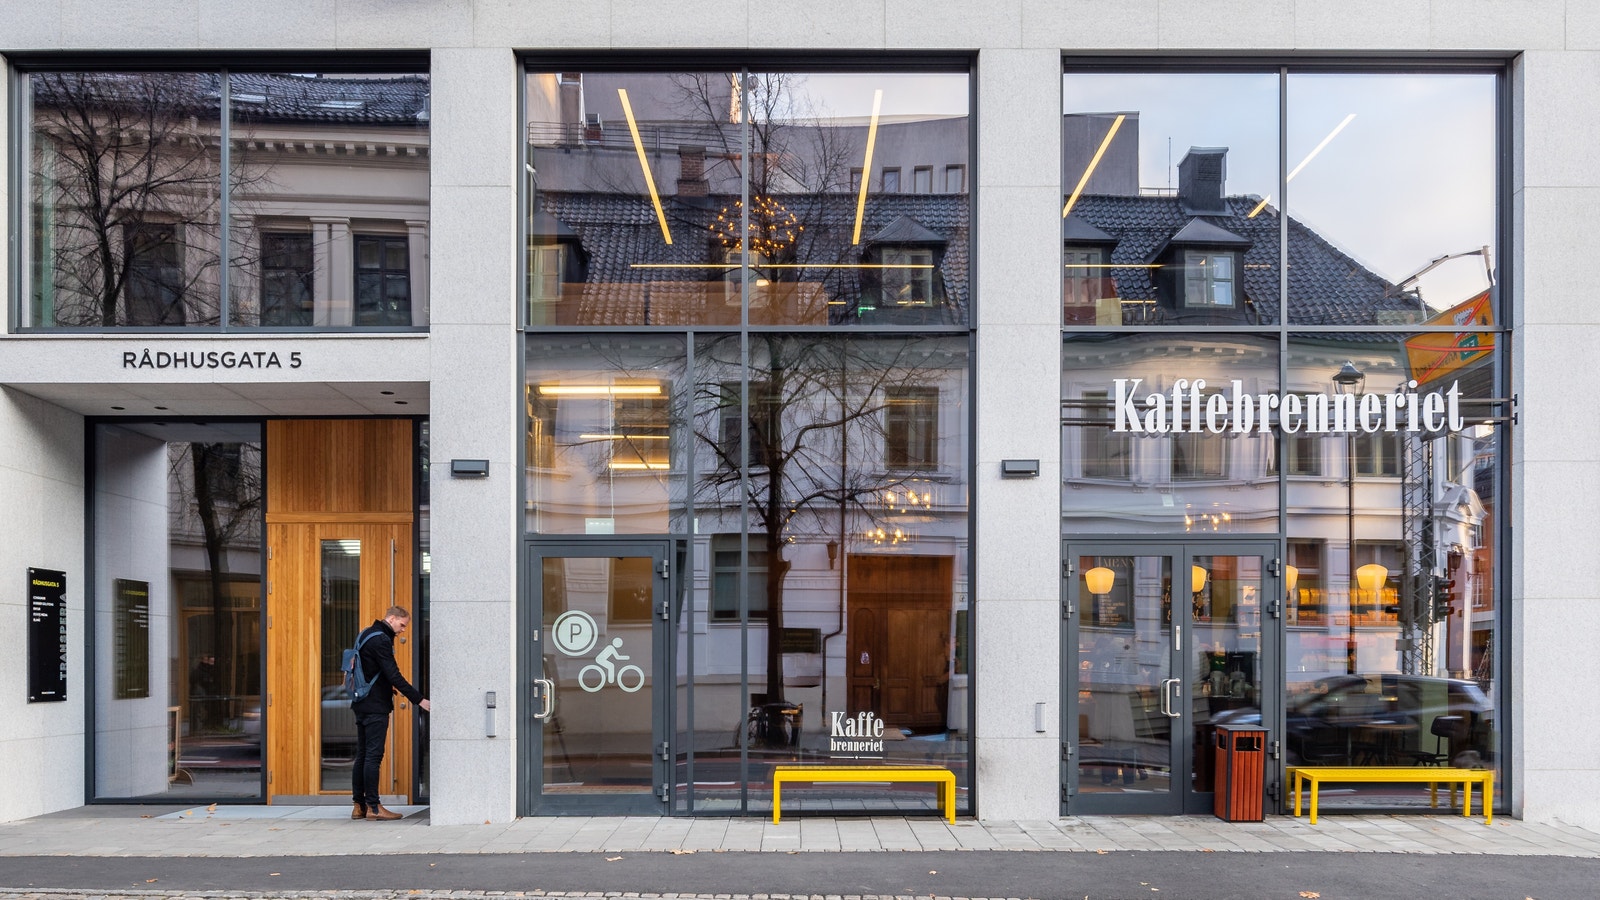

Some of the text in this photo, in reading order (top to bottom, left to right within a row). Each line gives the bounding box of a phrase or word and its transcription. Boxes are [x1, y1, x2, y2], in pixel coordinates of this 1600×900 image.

[123, 348, 302, 369] RÅDHUSGATA 5
[1112, 378, 1464, 434] Kaffebrenneriet
[830, 711, 884, 737] Kaffe
[830, 738, 884, 752] brenneriet
